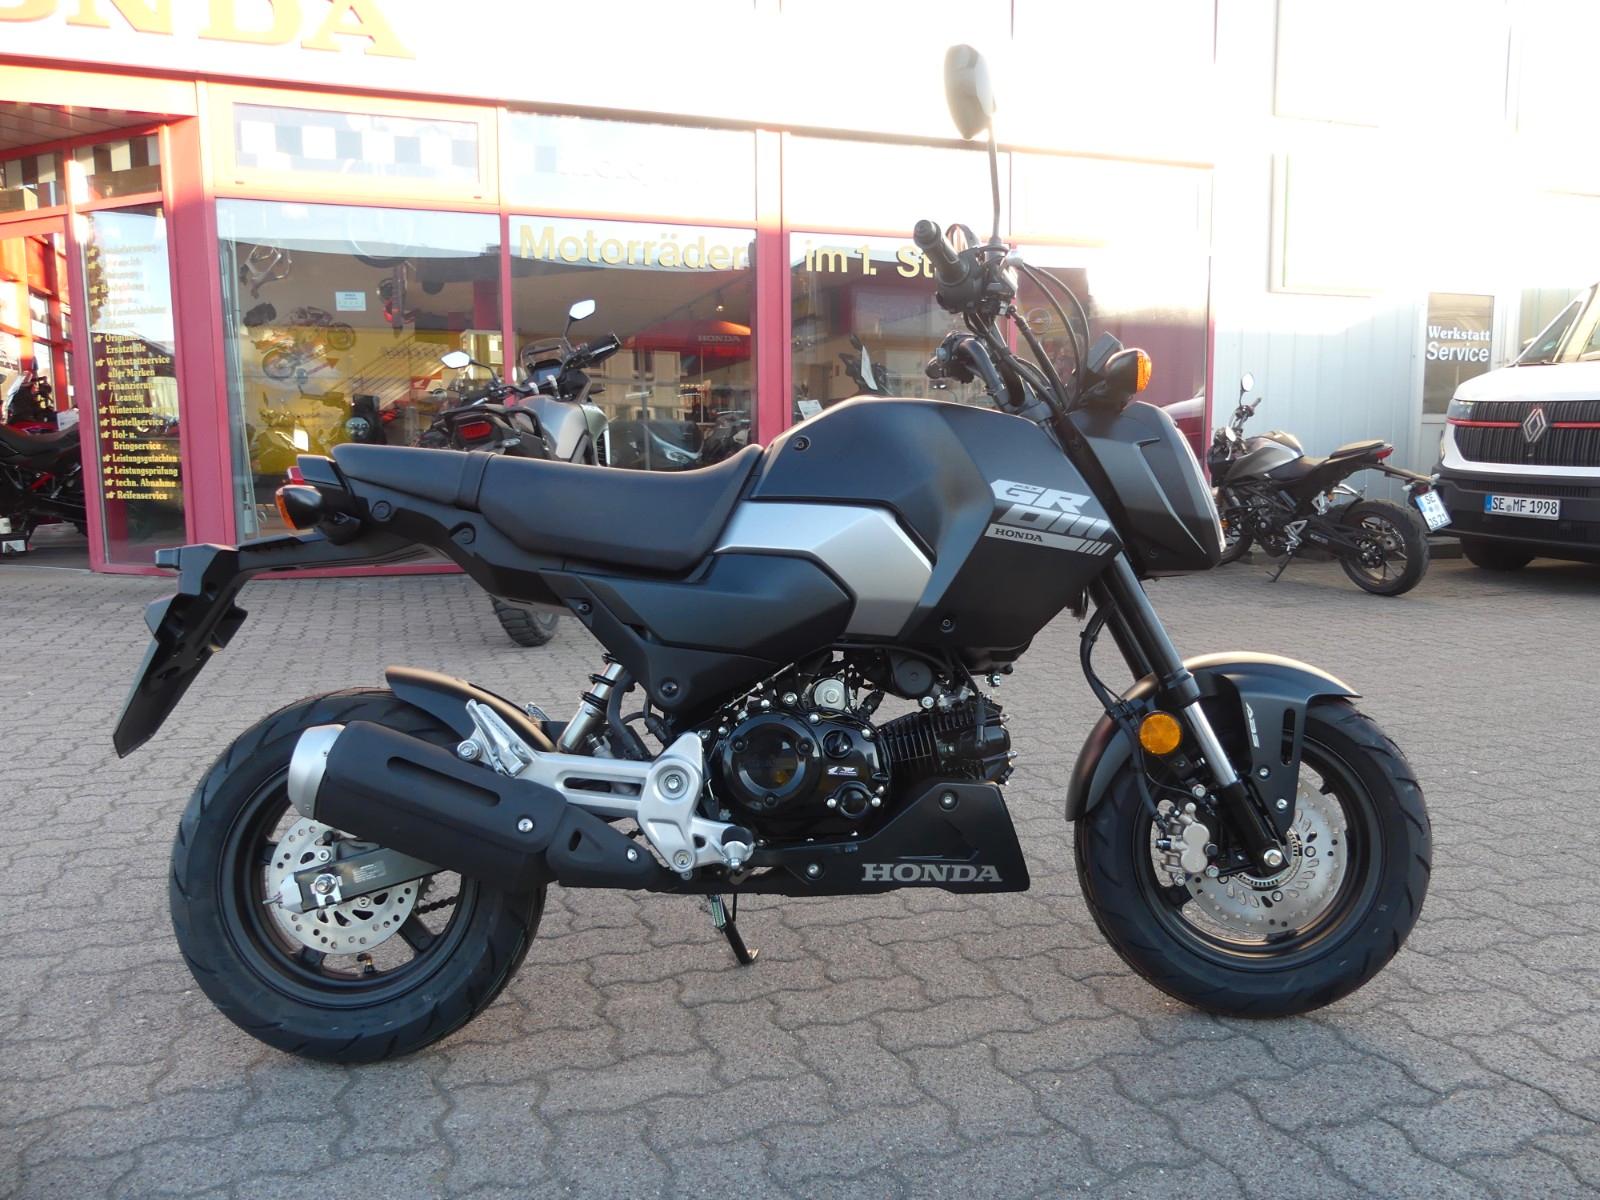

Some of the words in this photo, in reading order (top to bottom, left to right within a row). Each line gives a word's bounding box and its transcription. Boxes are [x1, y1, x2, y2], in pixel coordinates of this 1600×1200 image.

[519, 224, 748, 271] Motorräder
[805, 240, 849, 273] im
[896, 246, 938, 279] St
[1428, 325, 1490, 341] Werkstatt
[1426, 341, 1489, 362] Service
[108, 382, 157, 390] Finanzierun
[111, 418, 164, 427] Bestellservice
[113, 441, 161, 451] Bringservice
[114, 466, 178, 476] Leistungsprüfung
[117, 490, 168, 500] Reifenservice
[1492, 497, 1505, 511] SE
[1512, 498, 1527, 513] MF
[1529, 500, 1558, 515] 1998
[995, 527, 1042, 542] HONDA
[861, 863, 1003, 883] HONDA
